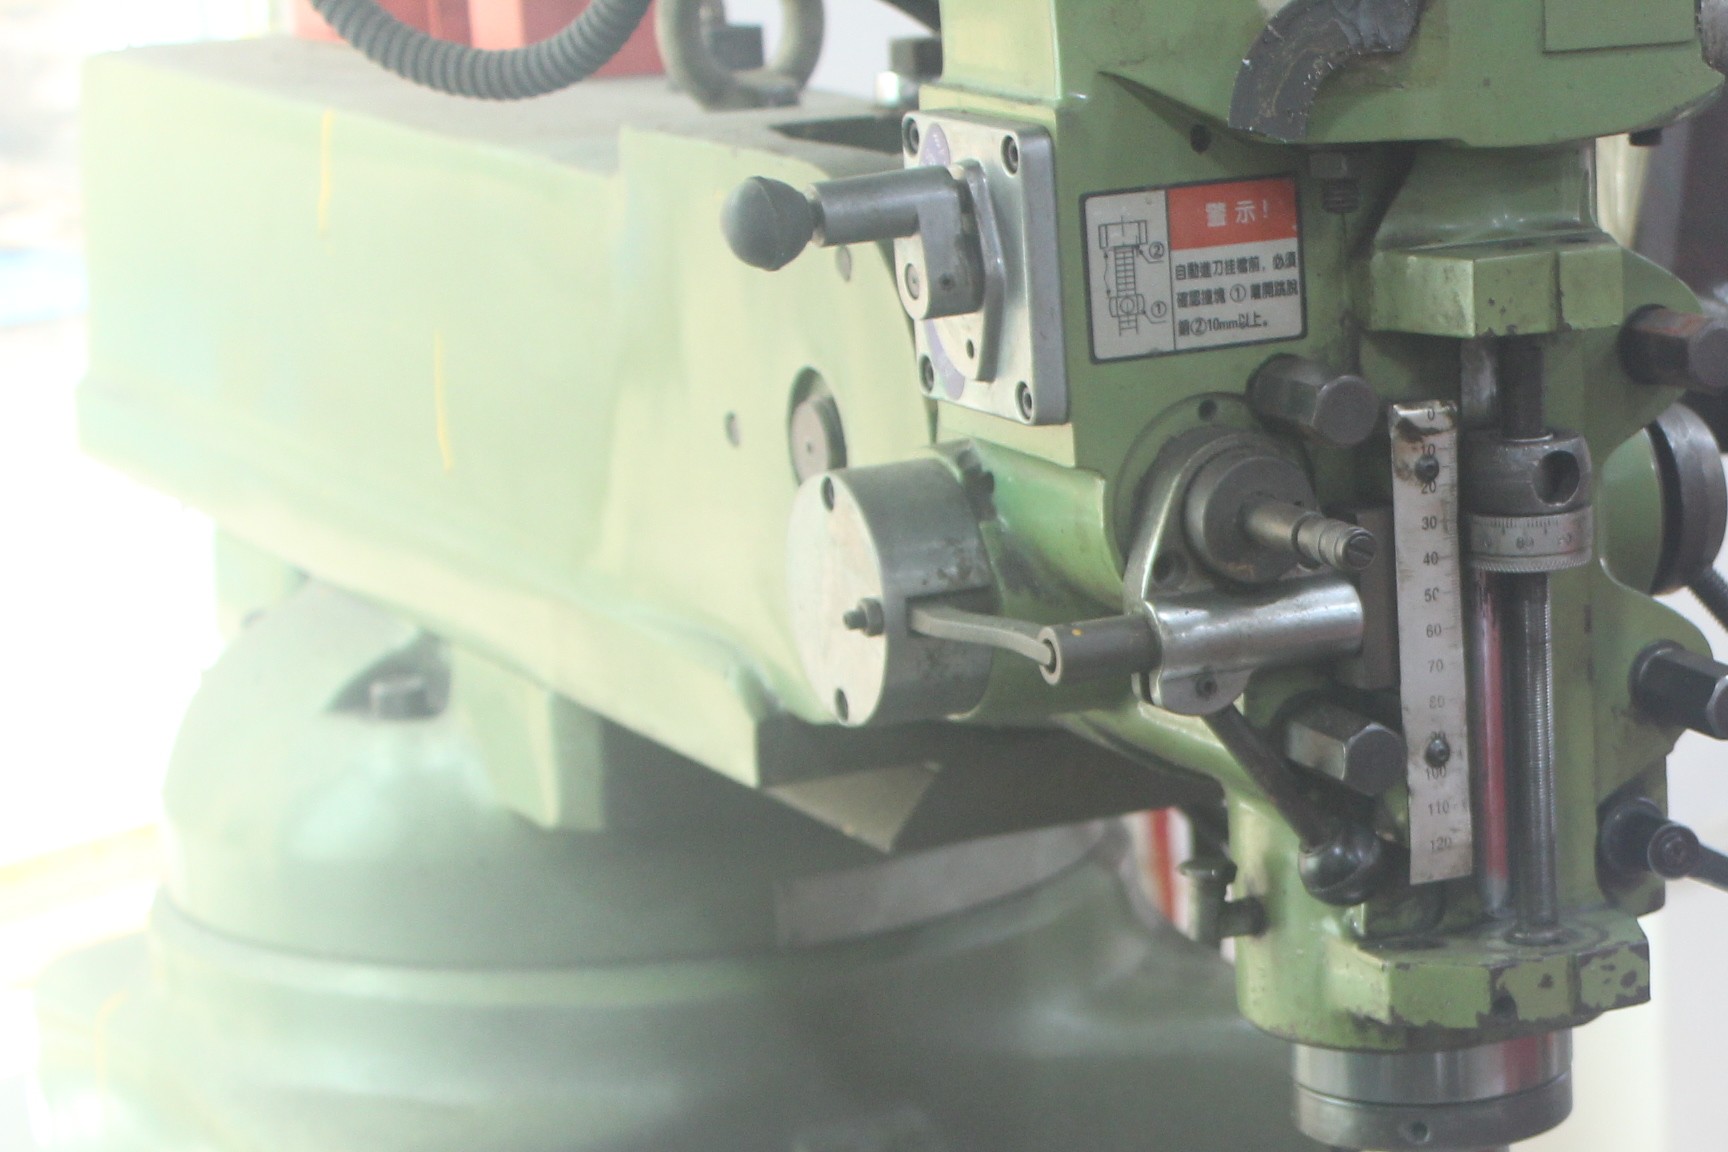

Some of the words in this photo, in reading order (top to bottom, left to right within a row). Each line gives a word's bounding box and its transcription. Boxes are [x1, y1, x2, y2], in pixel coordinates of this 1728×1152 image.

[1427, 408, 1436, 421] 0
[1422, 443, 1436, 457] 10
[1421, 480, 1437, 495] 20
[1421, 515, 1437, 530] 30
[1423, 551, 1439, 566] 40
[1424, 586, 1440, 602] 50
[1426, 623, 1442, 638] 60
[1428, 659, 1444, 673] 70
[1429, 695, 1445, 709] 80
[1428, 799, 1449, 816] 110
[1430, 836, 1452, 854] 120
